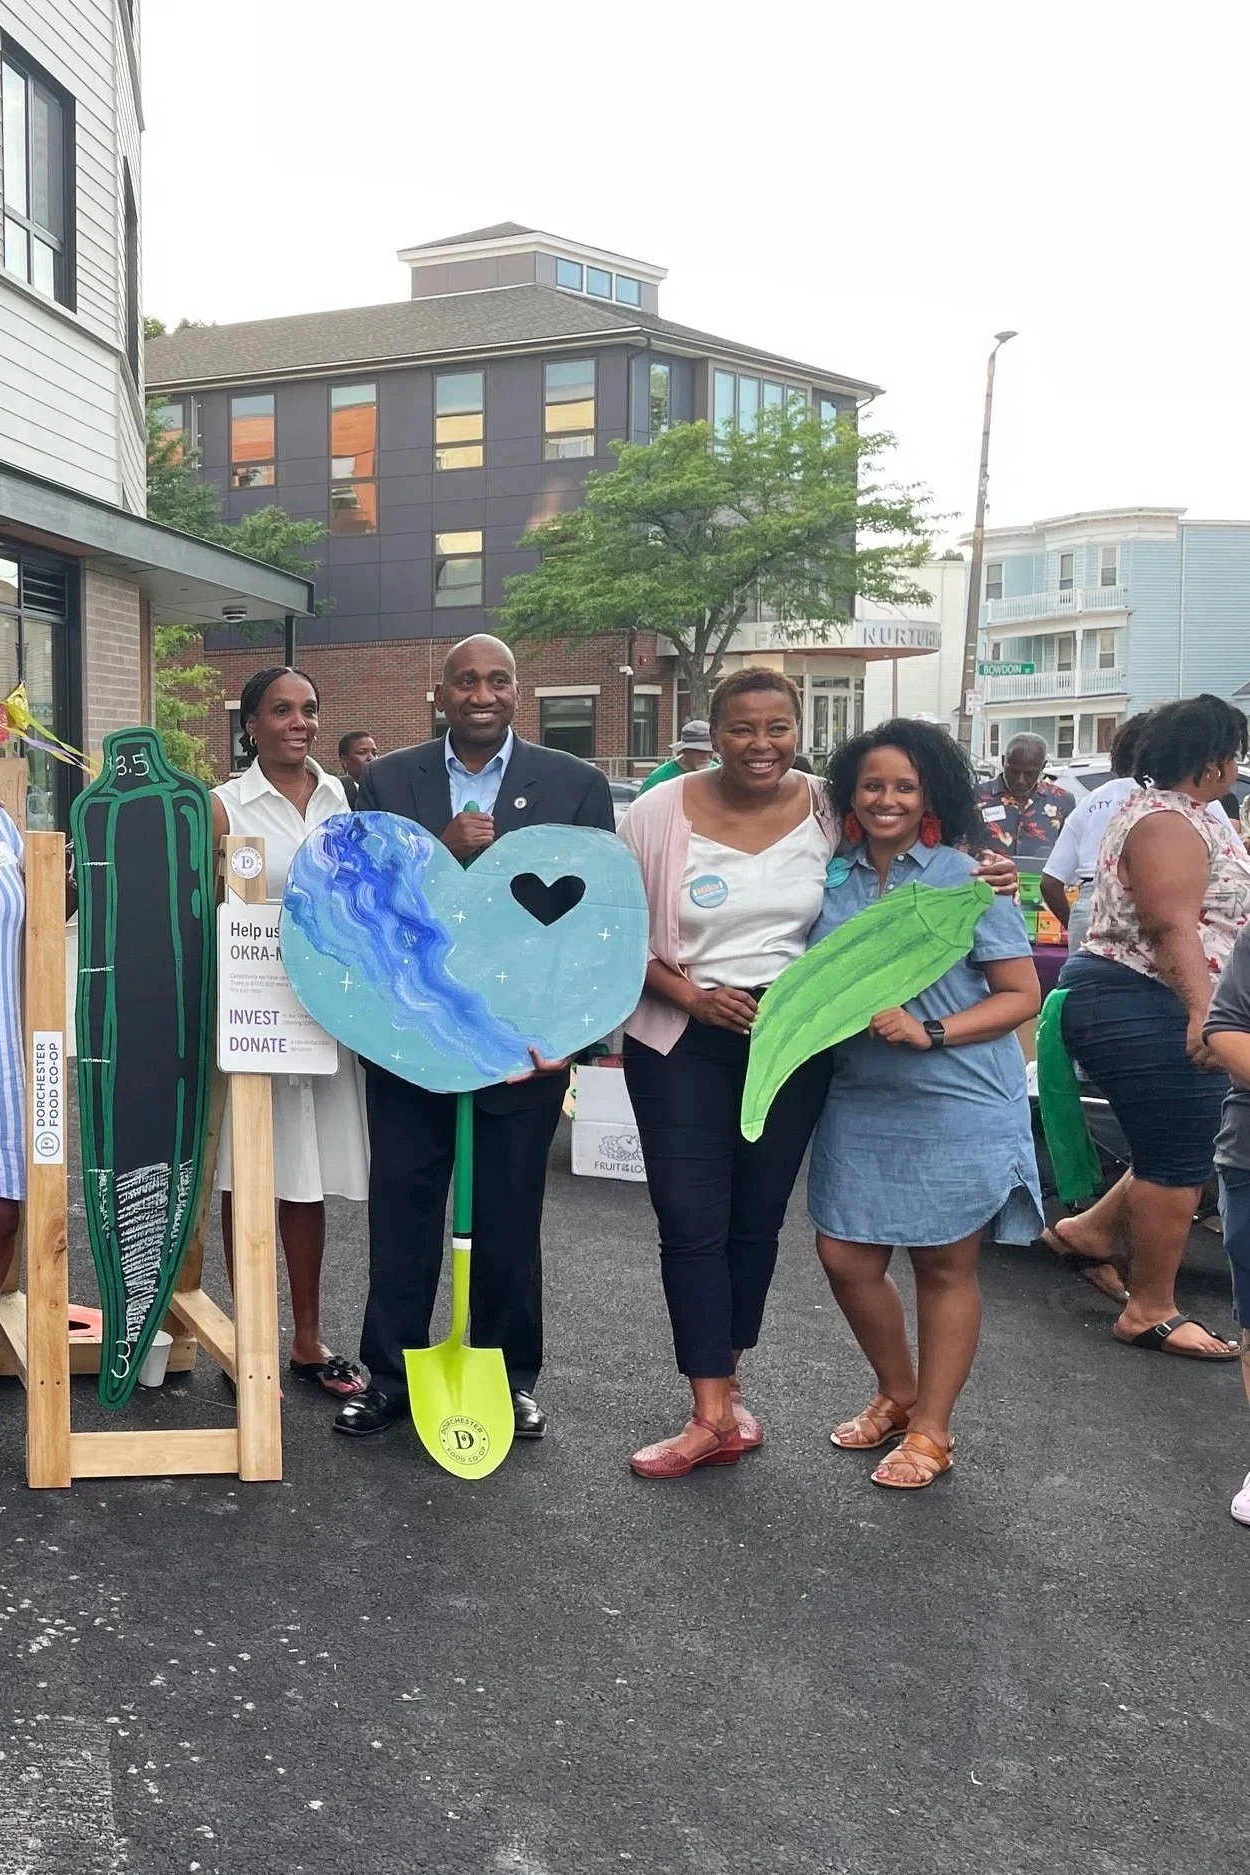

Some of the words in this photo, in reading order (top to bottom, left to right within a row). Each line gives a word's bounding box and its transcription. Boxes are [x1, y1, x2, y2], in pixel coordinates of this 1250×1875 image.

[983, 664, 1022, 675] BOWDOIN
[1088, 799, 1112, 813] CTY
[230, 921, 262, 941] Help
[265, 923, 280, 938] us
[229, 1009, 280, 1026] INVEST
[229, 1036, 287, 1053] DONATE
[49, 1042, 59, 1085] CO-OP
[36, 1042, 46, 1127] DORCHESTER
[49, 1088, 59, 1127] FOOD
[594, 1161, 621, 1172] FRUIT
[440, 1417, 484, 1435] DORCHESTER
[446, 1447, 466, 1463] FOOD
[467, 1446, 487, 1463] CO-OP
